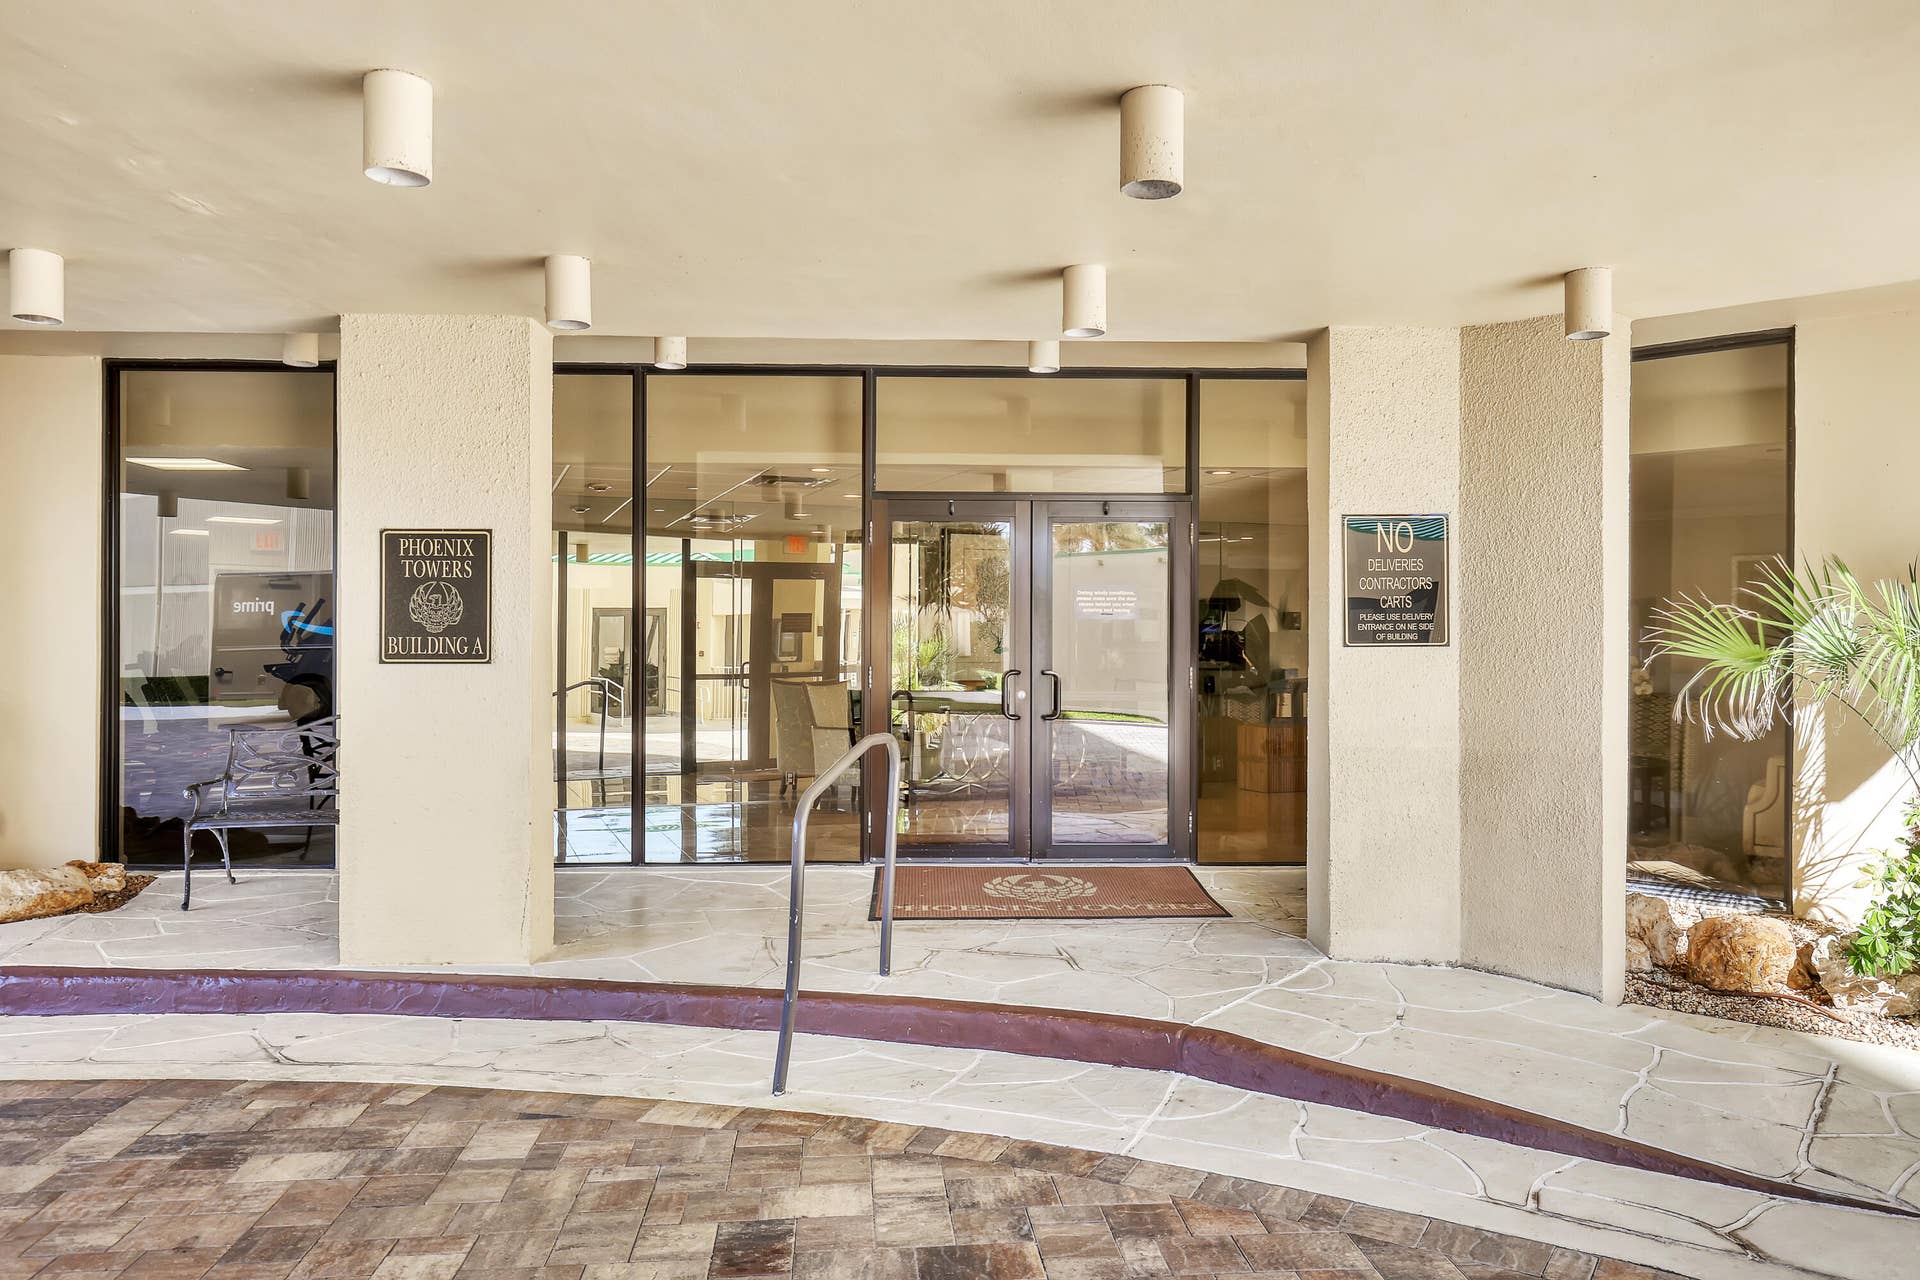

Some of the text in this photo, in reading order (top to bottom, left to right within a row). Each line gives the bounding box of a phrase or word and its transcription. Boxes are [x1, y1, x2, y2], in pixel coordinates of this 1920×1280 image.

[1377, 521, 1414, 553] NO
[399, 538, 475, 557] PHOENIX
[400, 559, 473, 579] TOWERS
[1368, 558, 1424, 571] DELIVERIES
[1359, 577, 1433, 590] CONTRACTORS
[1380, 595, 1413, 609] CARTS
[1360, 613, 1434, 621] PLEASE USE DELIVERY
[1357, 622, 1435, 631] ENTRANCE ON NE SIDE
[1375, 632, 1418, 641] OF BUILDING
[387, 636, 485, 655] BUILDING A
